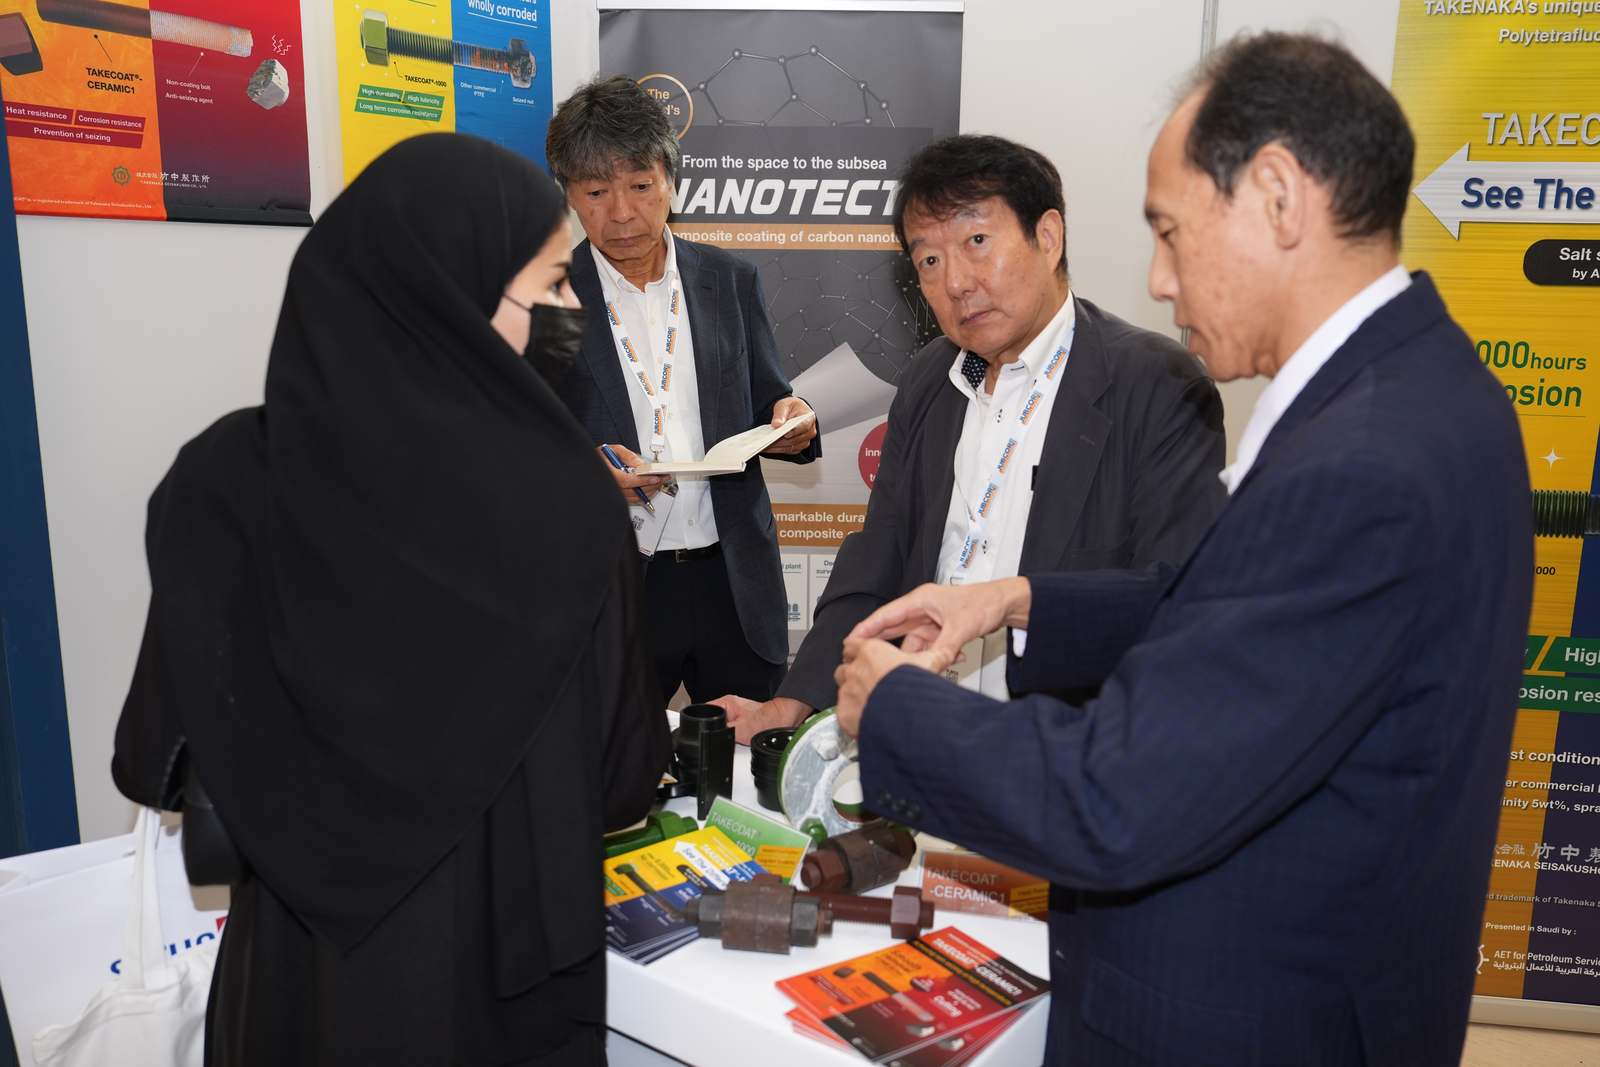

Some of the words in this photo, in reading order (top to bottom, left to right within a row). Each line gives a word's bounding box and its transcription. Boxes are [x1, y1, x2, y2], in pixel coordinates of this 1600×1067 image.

[497, 5, 537, 21] corroded
[1424, 0, 1538, 15] TAKENAKA's
[87, 80, 135, 94] CERAMIC1
[166, 79, 200, 90] Non-coating
[165, 92, 198, 103] Anti-seizing
[647, 88, 670, 100] The
[6, 106, 26, 115] Heat
[27, 108, 68, 120] resistance
[360, 102, 373, 111] Long
[78, 115, 110, 124] Corrosion
[111, 119, 142, 128] resistance
[34, 127, 74, 138] Prevention
[85, 133, 111, 142] seizing
[682, 155, 718, 169] From
[721, 155, 743, 169] the
[747, 158, 789, 172] space
[792, 157, 807, 169] to
[811, 156, 834, 170] the
[838, 156, 887, 170] subsea
[1461, 177, 1524, 209] See
[1533, 178, 1595, 209] The
[736, 230, 786, 244] coating
[790, 230, 804, 243] of
[807, 231, 854, 243] carbon
[1559, 247, 1592, 261] Salt
[1572, 268, 1588, 280] by
[773, 512, 834, 522] markable
[779, 528, 844, 541] composite
[785, 562, 801, 570] plant
[1565, 647, 1600, 666] Hig
[1505, 779, 1519, 788] er
[1520, 781, 1594, 793] commercial
[1502, 796, 1529, 809] inity
[1531, 799, 1570, 811] 5wt%,
[712, 812, 758, 840] TAKECOAT
[1492, 859, 1531, 869] ENAKA
[927, 867, 998, 885] TAKECOAT
[1495, 894, 1540, 903] trademark
[1553, 897, 1595, 907] Takenaka
[1485, 923, 1526, 931] Presented
[1537, 926, 1560, 934] Saudi
[1494, 950, 1511, 959] AET
[1513, 951, 1526, 960] for
[1527, 952, 1573, 964] Petroleum
[1493, 961, 1525, 971] البترولية
[1555, 965, 1582, 975] العربية
